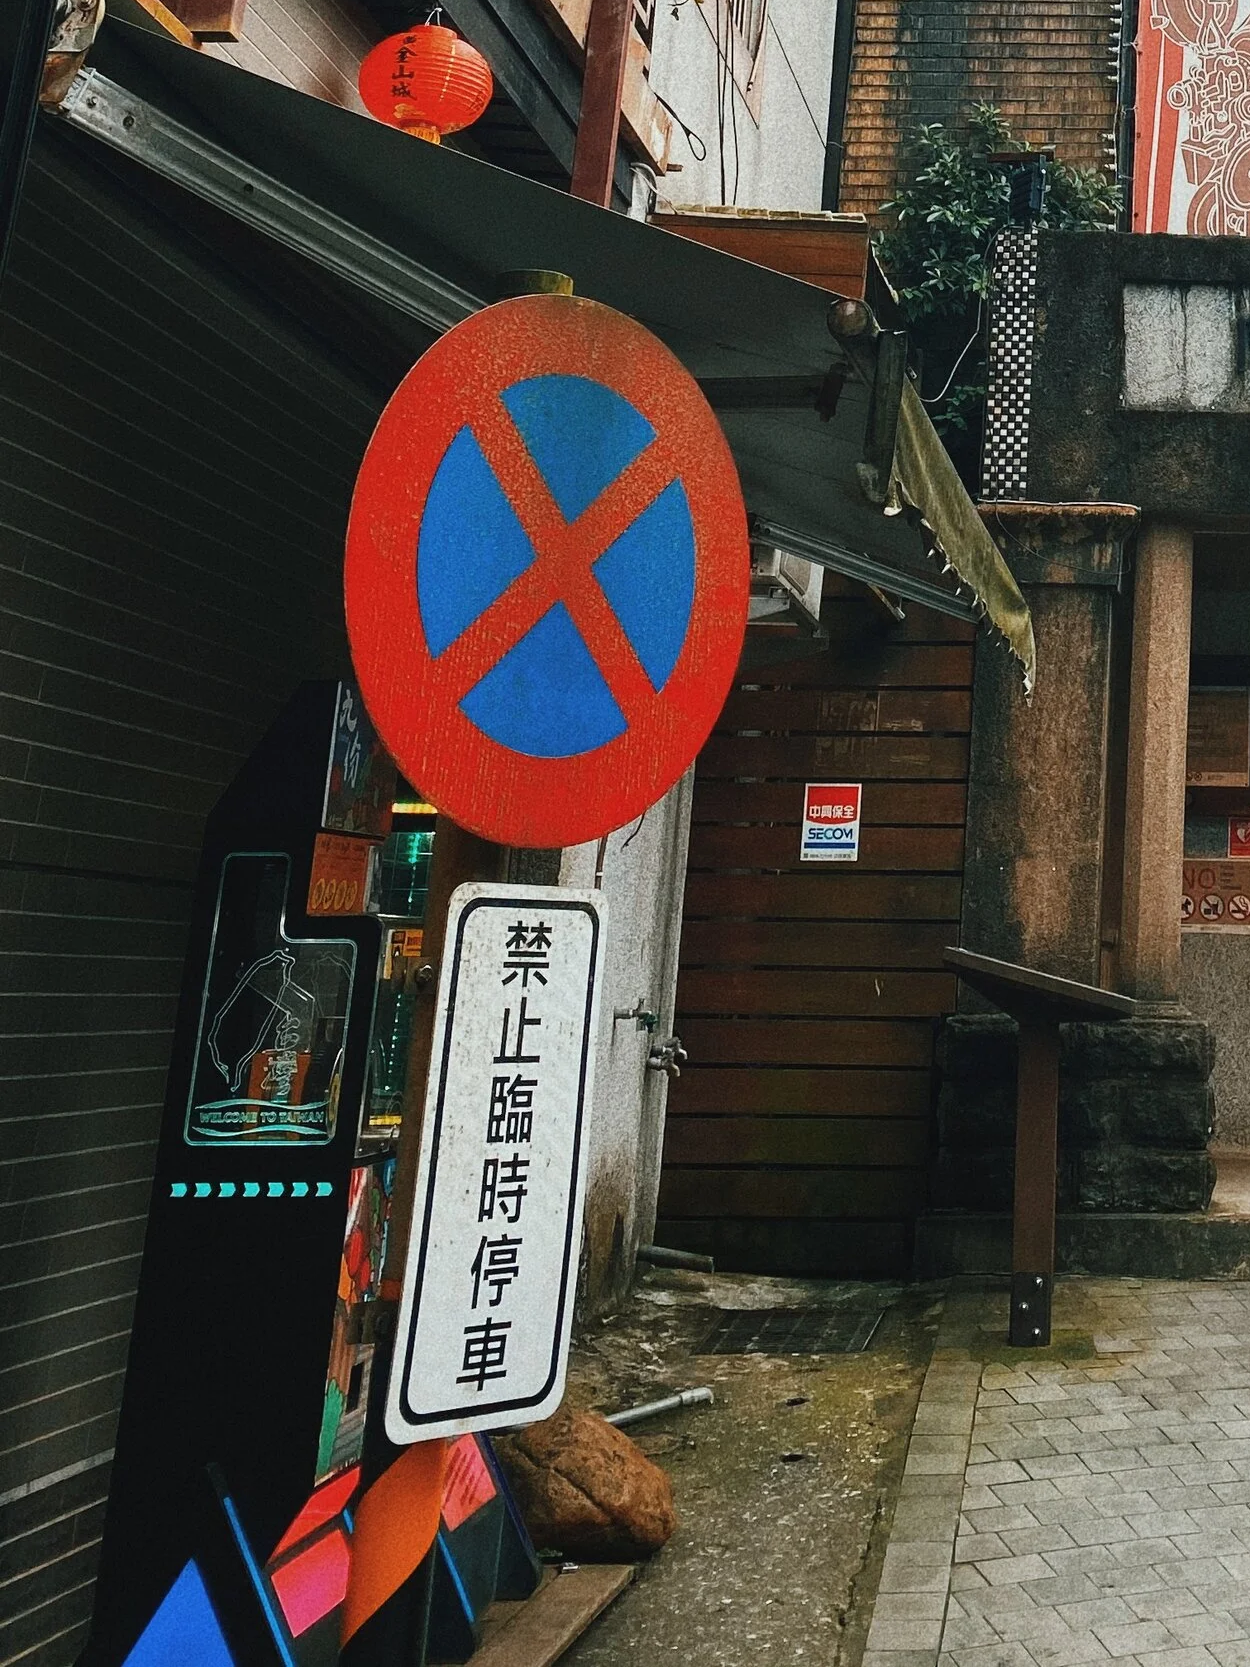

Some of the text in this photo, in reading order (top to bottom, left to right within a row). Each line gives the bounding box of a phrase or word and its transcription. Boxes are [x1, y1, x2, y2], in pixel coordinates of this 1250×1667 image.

[807, 827, 853, 840] SECOM
[199, 1110, 325, 1125] WELCOME TO TAIWAN
[455, 920, 553, 1392] 禁止臨時停車
